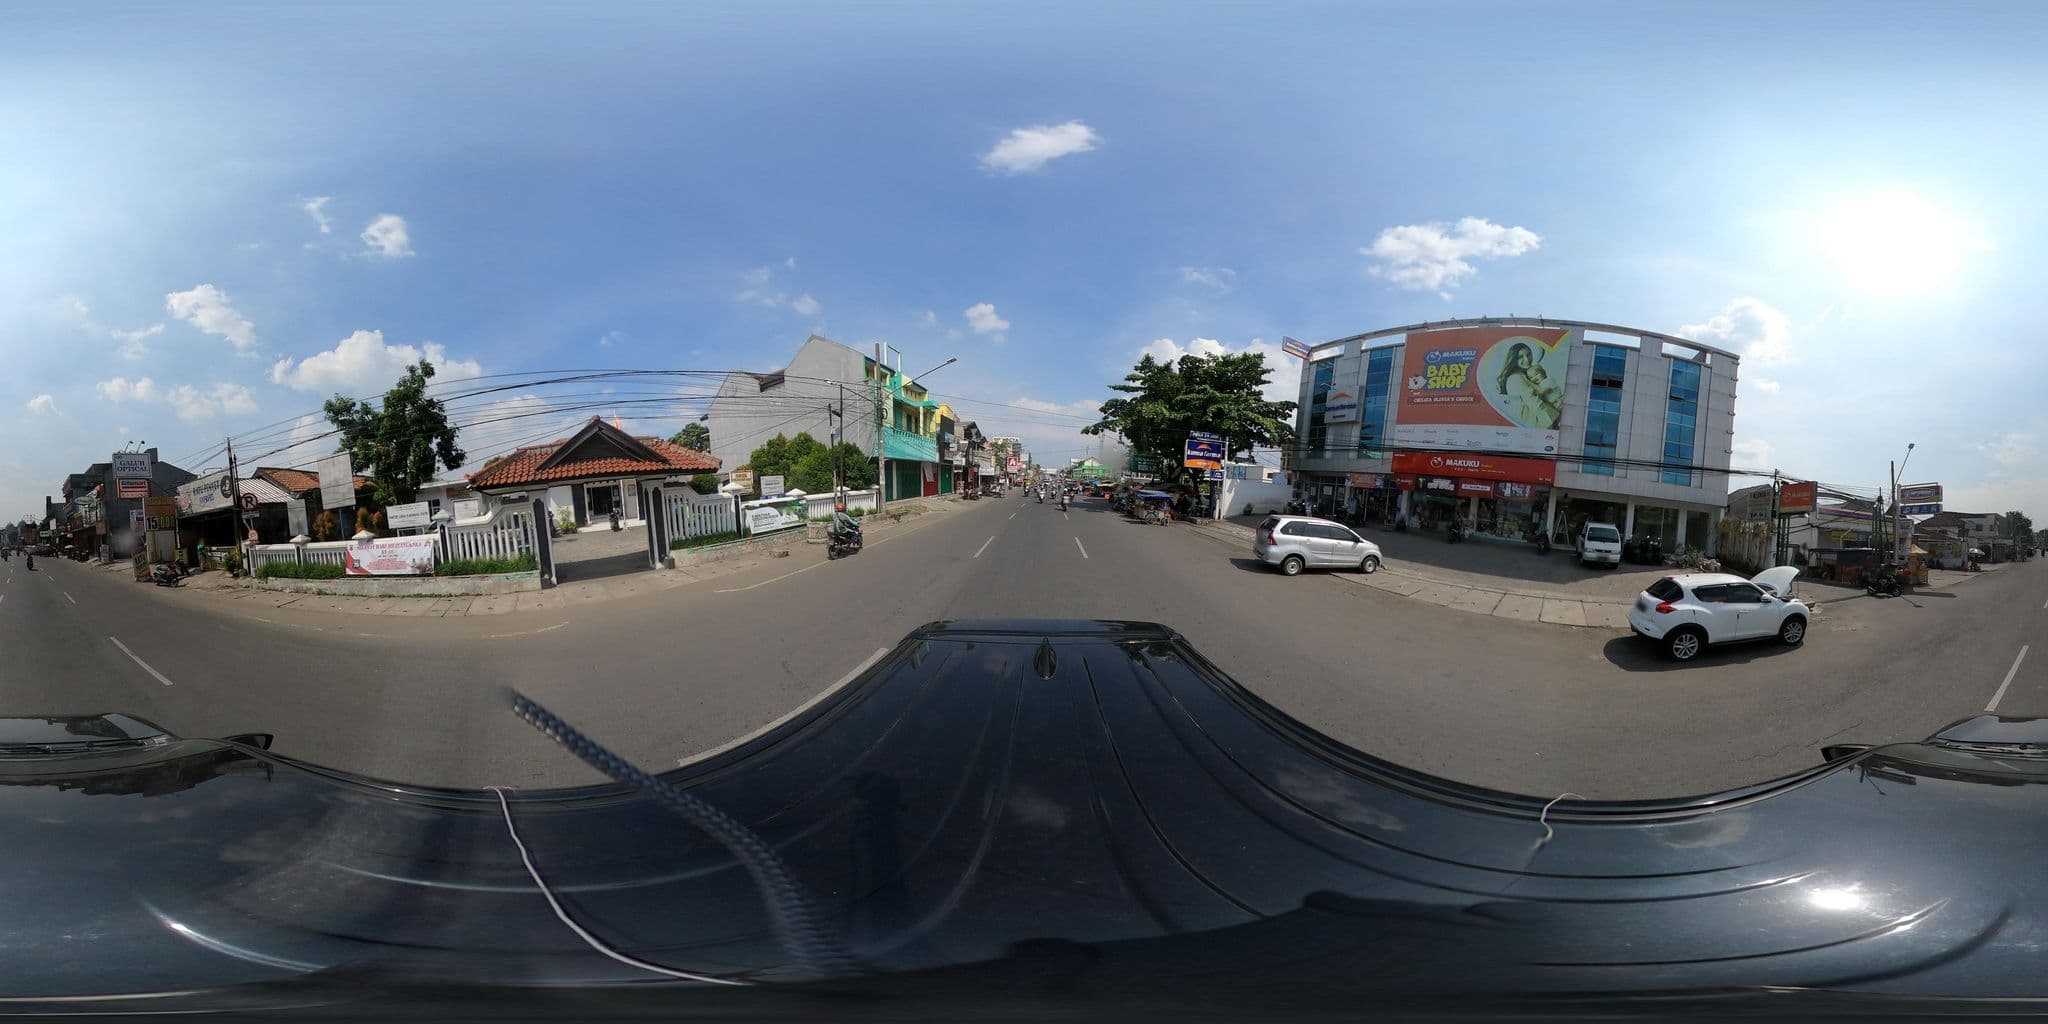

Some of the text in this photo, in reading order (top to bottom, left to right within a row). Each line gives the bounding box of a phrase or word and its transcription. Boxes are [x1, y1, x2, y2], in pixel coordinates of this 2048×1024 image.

[1442, 350, 1476, 358] MAKUKU
[1427, 364, 1470, 377] BABY
[1428, 376, 1466, 389] SHOP
[1446, 459, 1480, 467] MAKUKU
